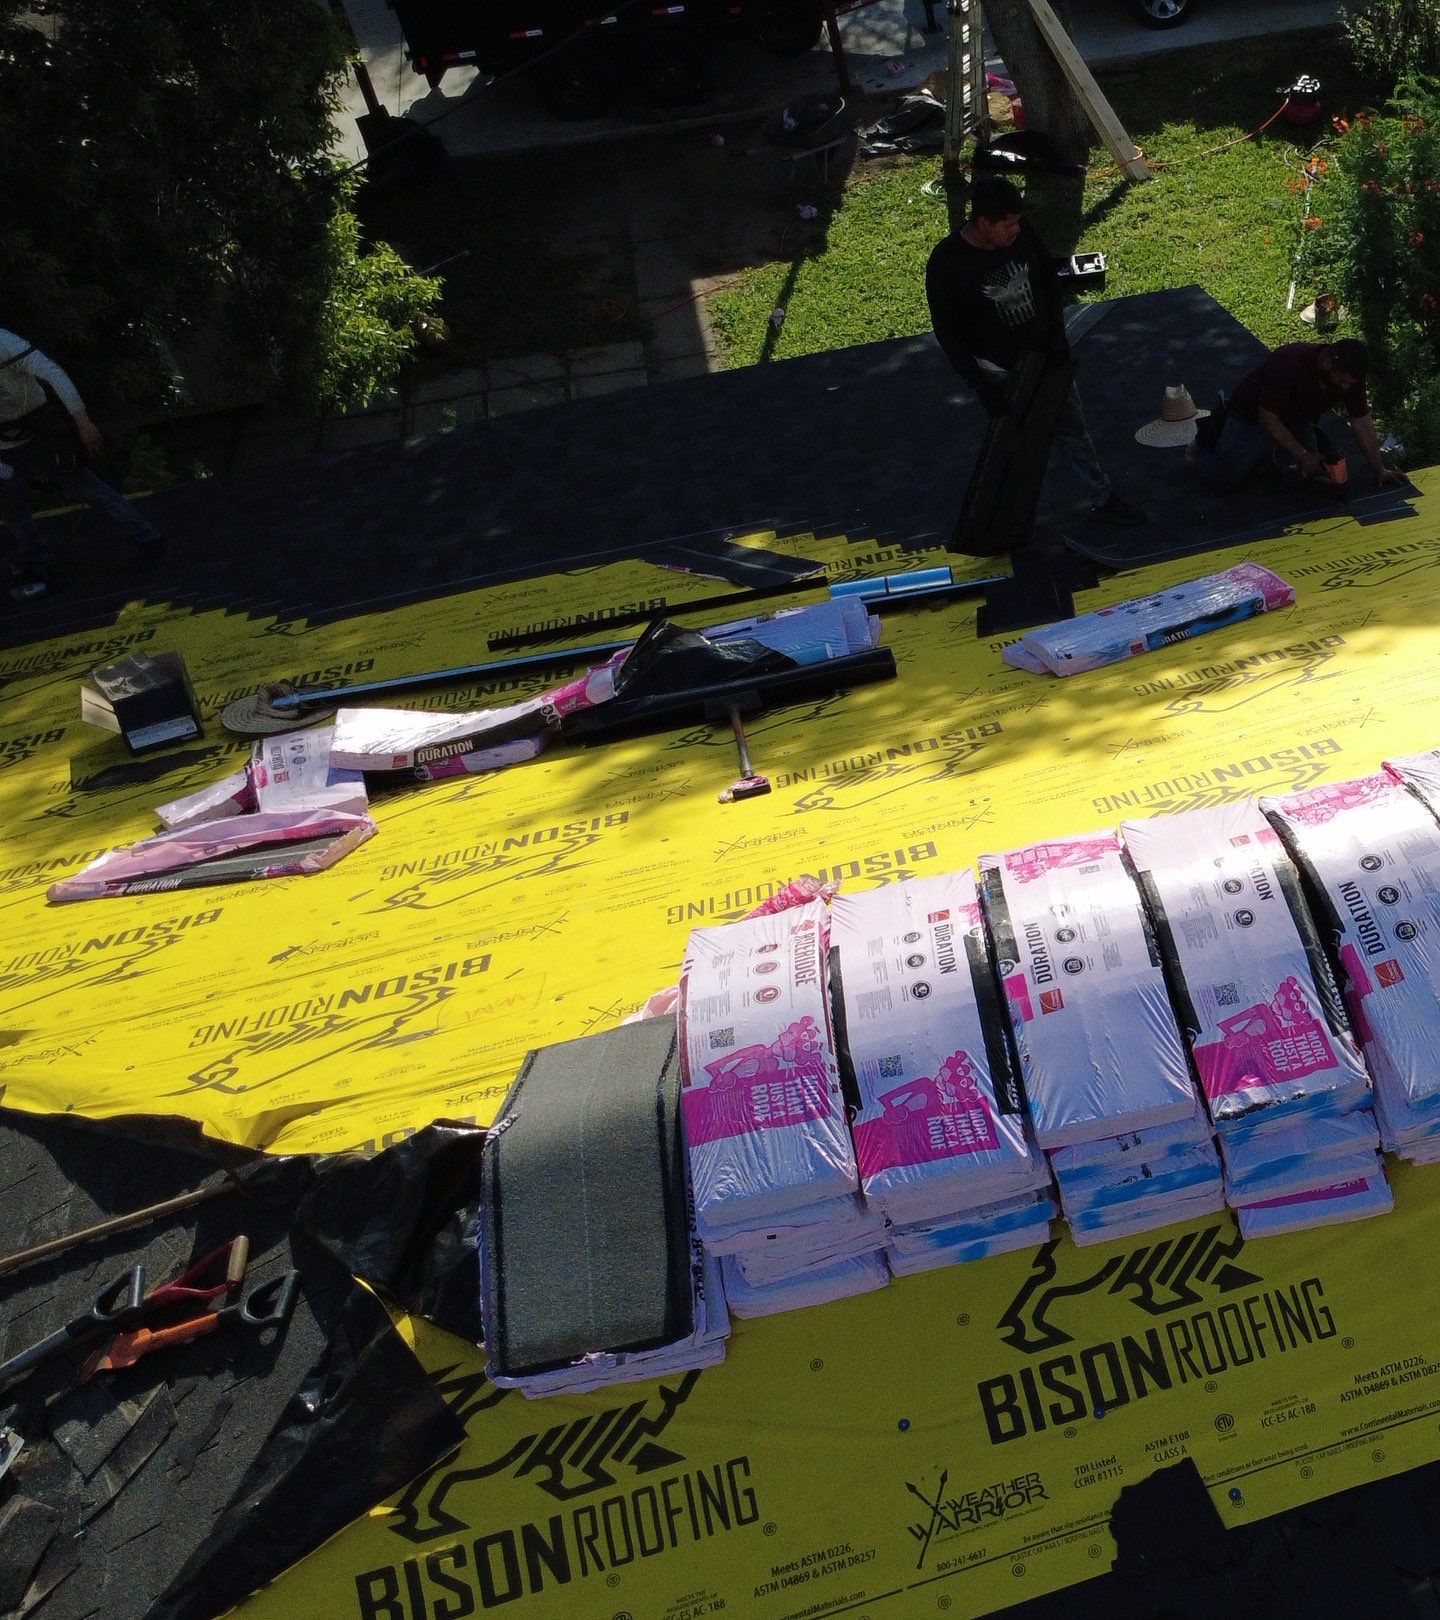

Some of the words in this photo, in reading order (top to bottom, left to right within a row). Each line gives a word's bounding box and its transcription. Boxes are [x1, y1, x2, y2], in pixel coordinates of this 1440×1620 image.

[416, 739, 475, 764] DURATION
[1338, 880, 1387, 957] DURATION
[934, 923, 958, 976] DURATION
[1023, 921, 1054, 986] DURATION
[1267, 1039, 1291, 1073] ROOF
[1281, 1036, 1297, 1060] JUST
[1293, 1033, 1315, 1067] THAN
[1308, 1030, 1330, 1063] MORE
[926, 1115, 948, 1151] ROOF
[953, 1110, 977, 1147] THAN
[969, 1107, 991, 1144] MORE
[1340, 1385, 1363, 1403] ASTM
[1399, 1368, 1423, 1386] ASTM
[1354, 1367, 1379, 1386] Meets
[1379, 1359, 1404, 1380] ASTM
[1145, 1436, 1169, 1453] ASTM
[1153, 1447, 1181, 1464] CLASS
[753, 1581, 779, 1598] ASTM
[821, 1559, 847, 1576] ASTM
[771, 1561, 800, 1578] Meets
[801, 1552, 827, 1568] ASTM
